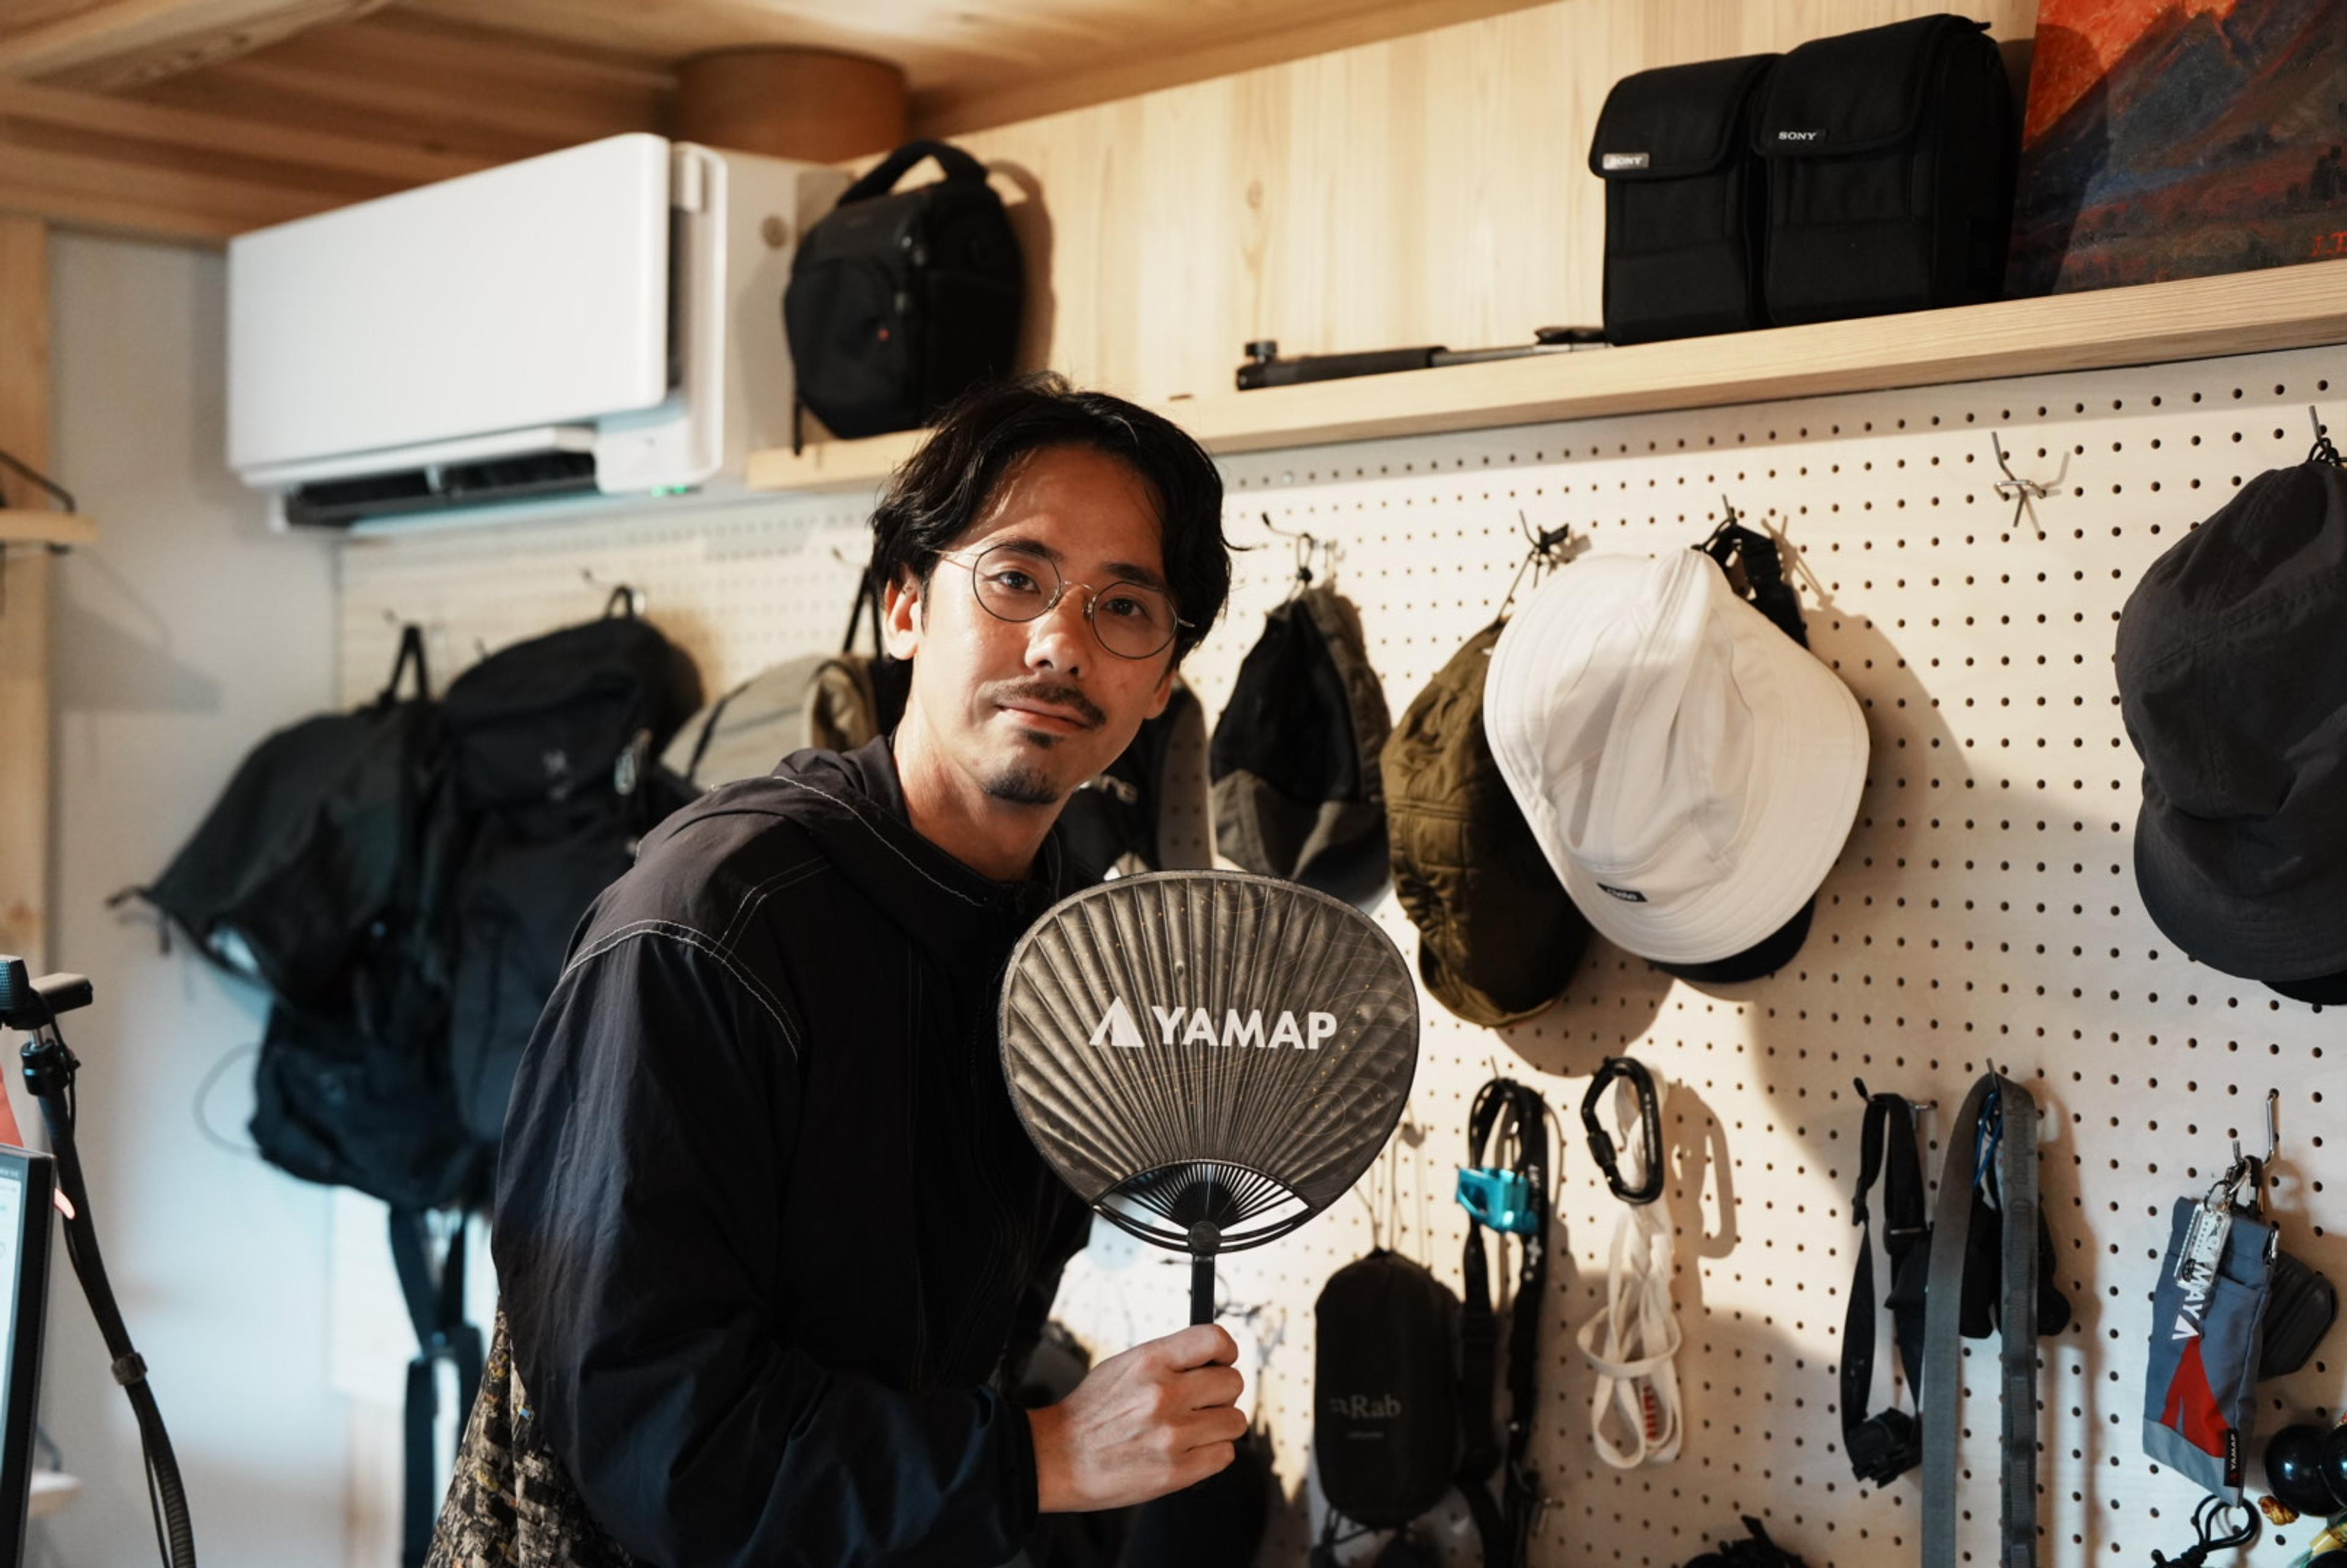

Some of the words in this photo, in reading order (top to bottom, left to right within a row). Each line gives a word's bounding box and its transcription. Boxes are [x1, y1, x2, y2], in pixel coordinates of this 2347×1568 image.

[1779, 131, 1816, 141] SONY
[1151, 1006, 1338, 1050] YAMAP
[1350, 1394, 1402, 1418] Rab
